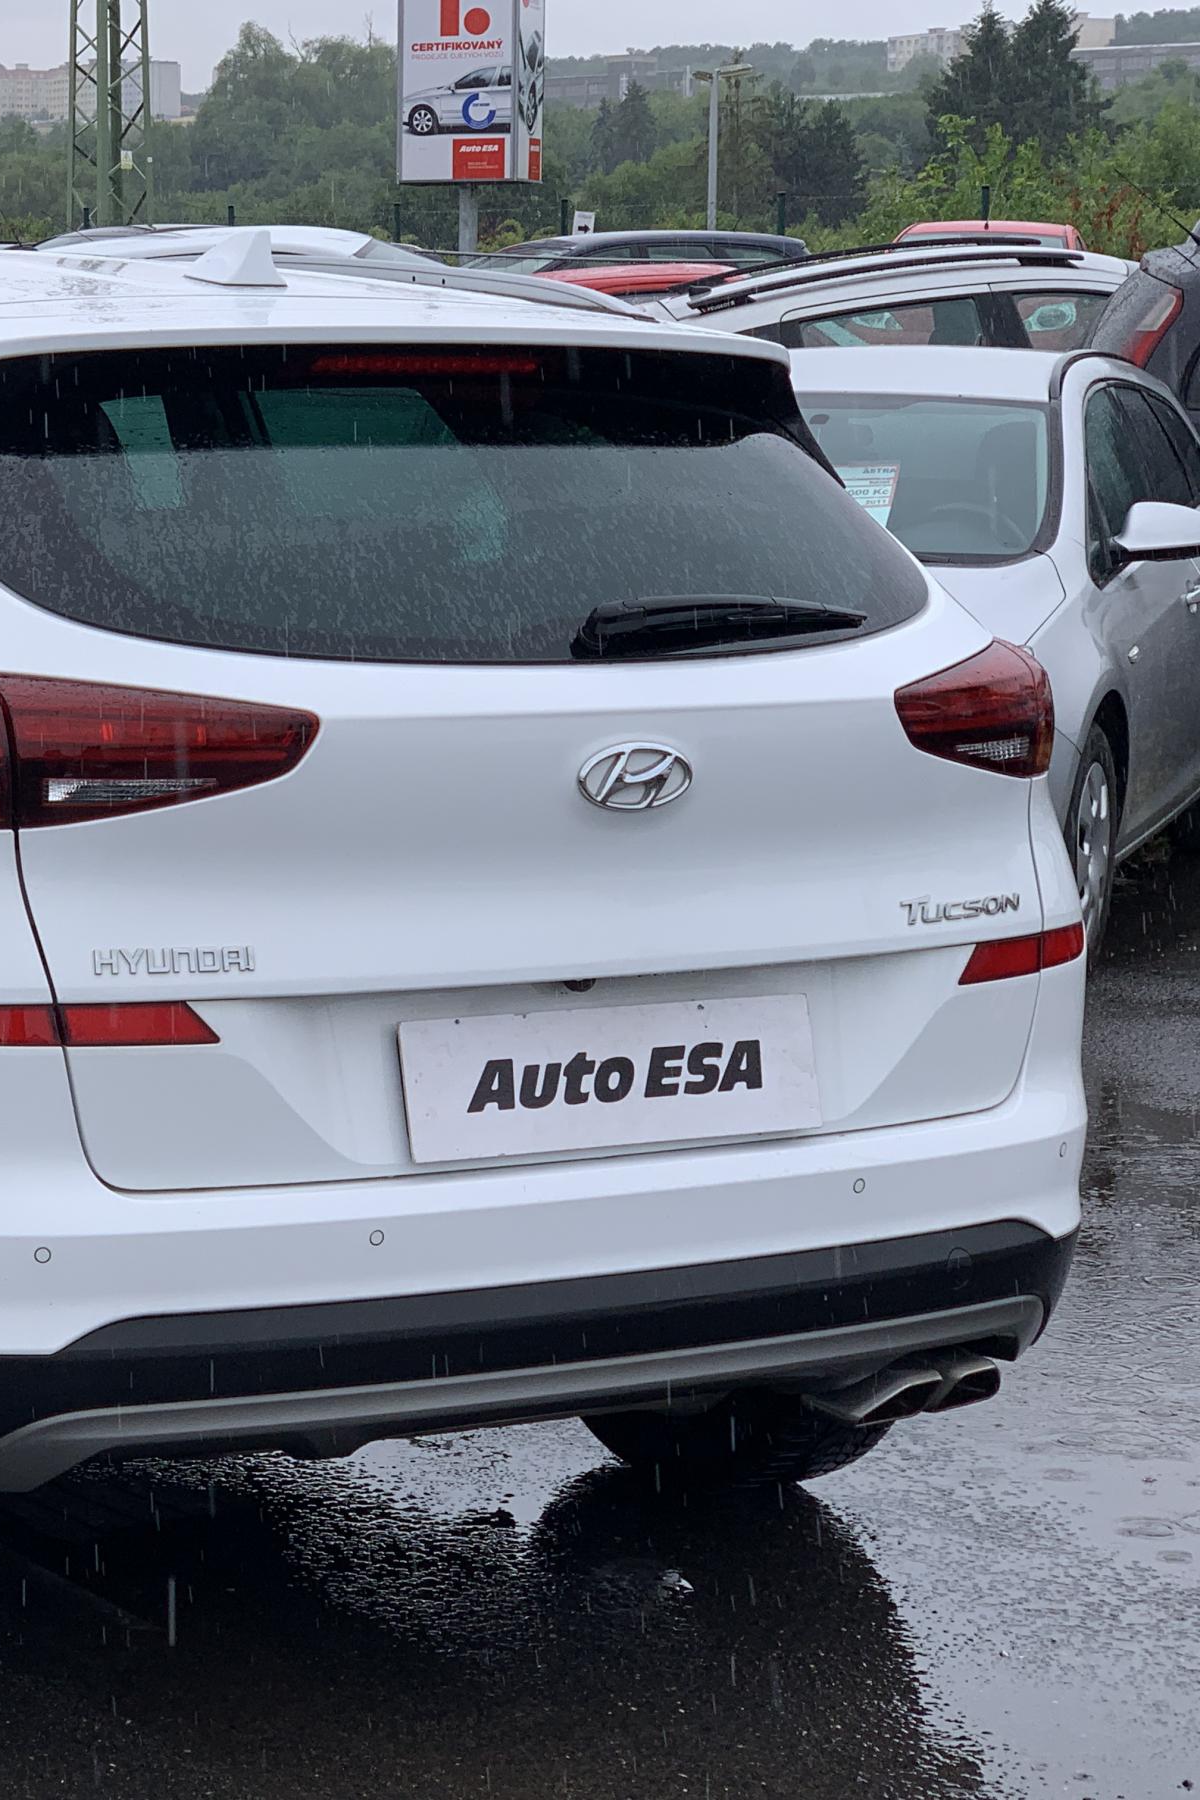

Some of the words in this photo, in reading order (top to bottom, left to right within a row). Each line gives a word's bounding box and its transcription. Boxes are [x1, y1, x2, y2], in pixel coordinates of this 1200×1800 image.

[411, 38, 503, 52] CERTIFIKOVANÝ
[482, 144, 499, 152] ESA
[92, 945, 255, 976] HYUNDAI
[466, 1051, 635, 1113] Auto
[644, 1039, 763, 1098] ESA
